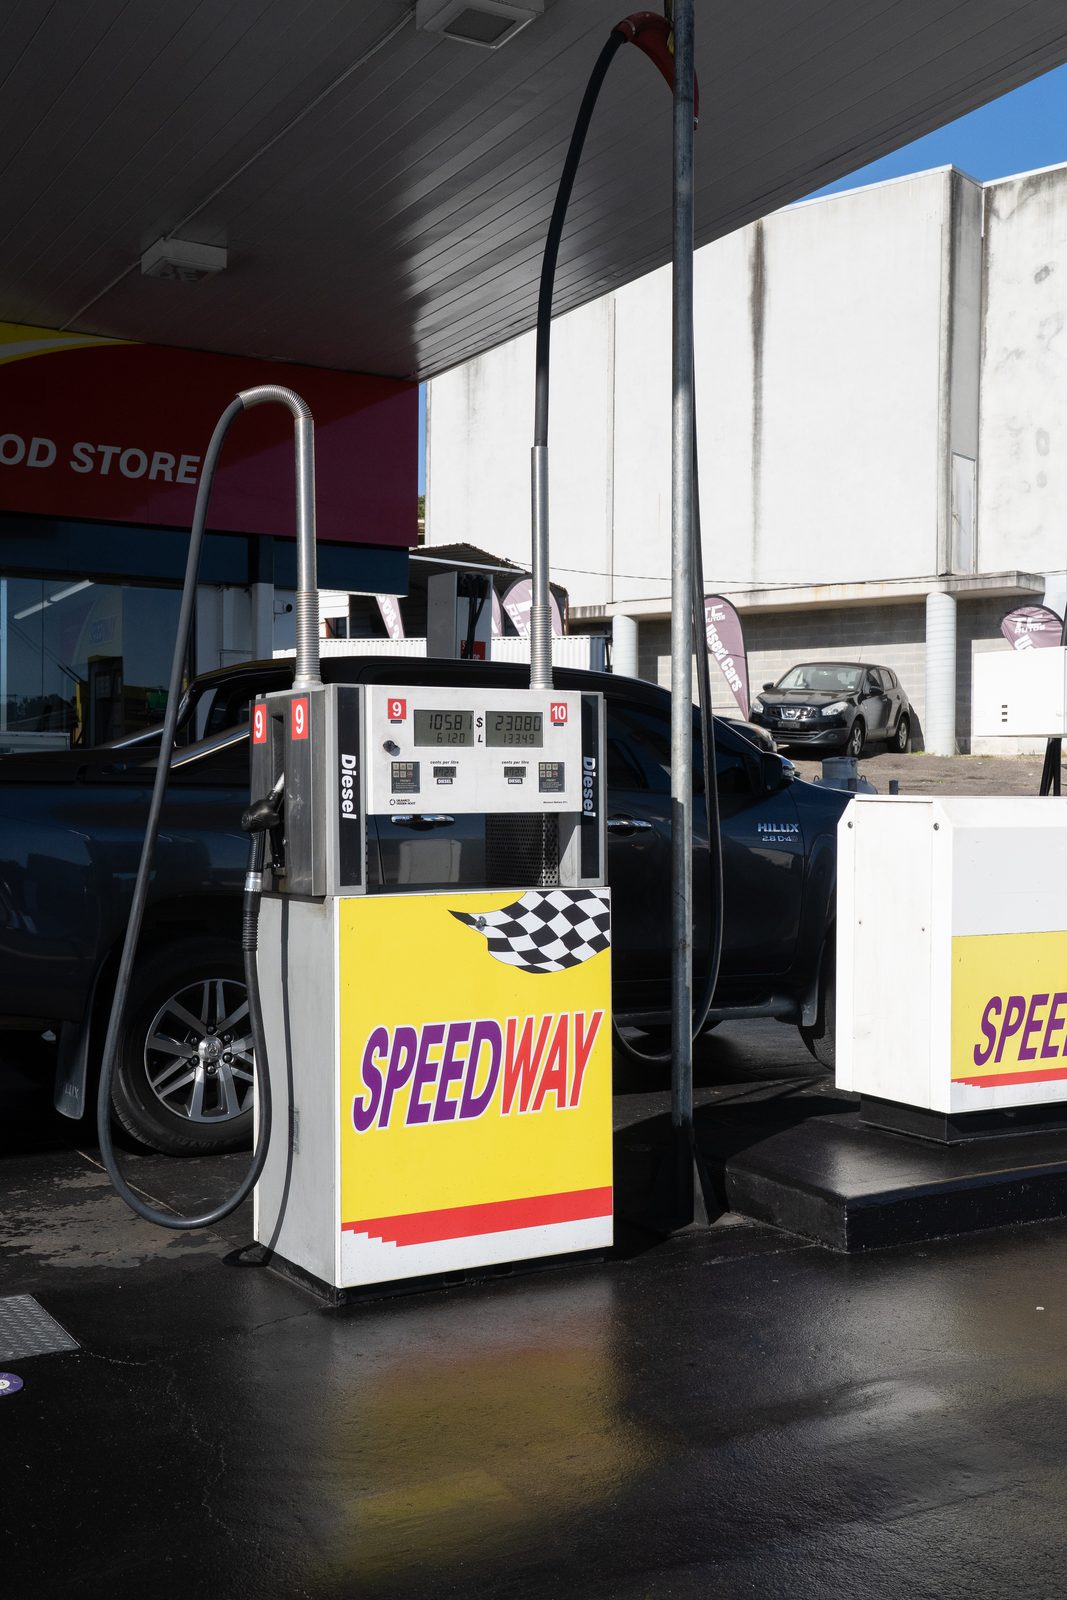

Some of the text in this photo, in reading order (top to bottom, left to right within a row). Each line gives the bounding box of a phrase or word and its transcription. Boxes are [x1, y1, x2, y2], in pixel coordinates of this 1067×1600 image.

[69, 442, 200, 484] STORE
[721, 657, 742, 692] Cars
[255, 710, 263, 738] 9
[295, 704, 304, 734] 9
[392, 702, 402, 717] 9
[476, 717, 484, 728] $
[552, 705, 567, 720] 10
[477, 734, 484, 743] L
[341, 754, 357, 820] Diesel
[583, 757, 597, 817] Diesel
[757, 823, 799, 833] HILUX
[973, 991, 1067, 1066] SPEE
[352, 1010, 605, 1133] SPEEDWAY
